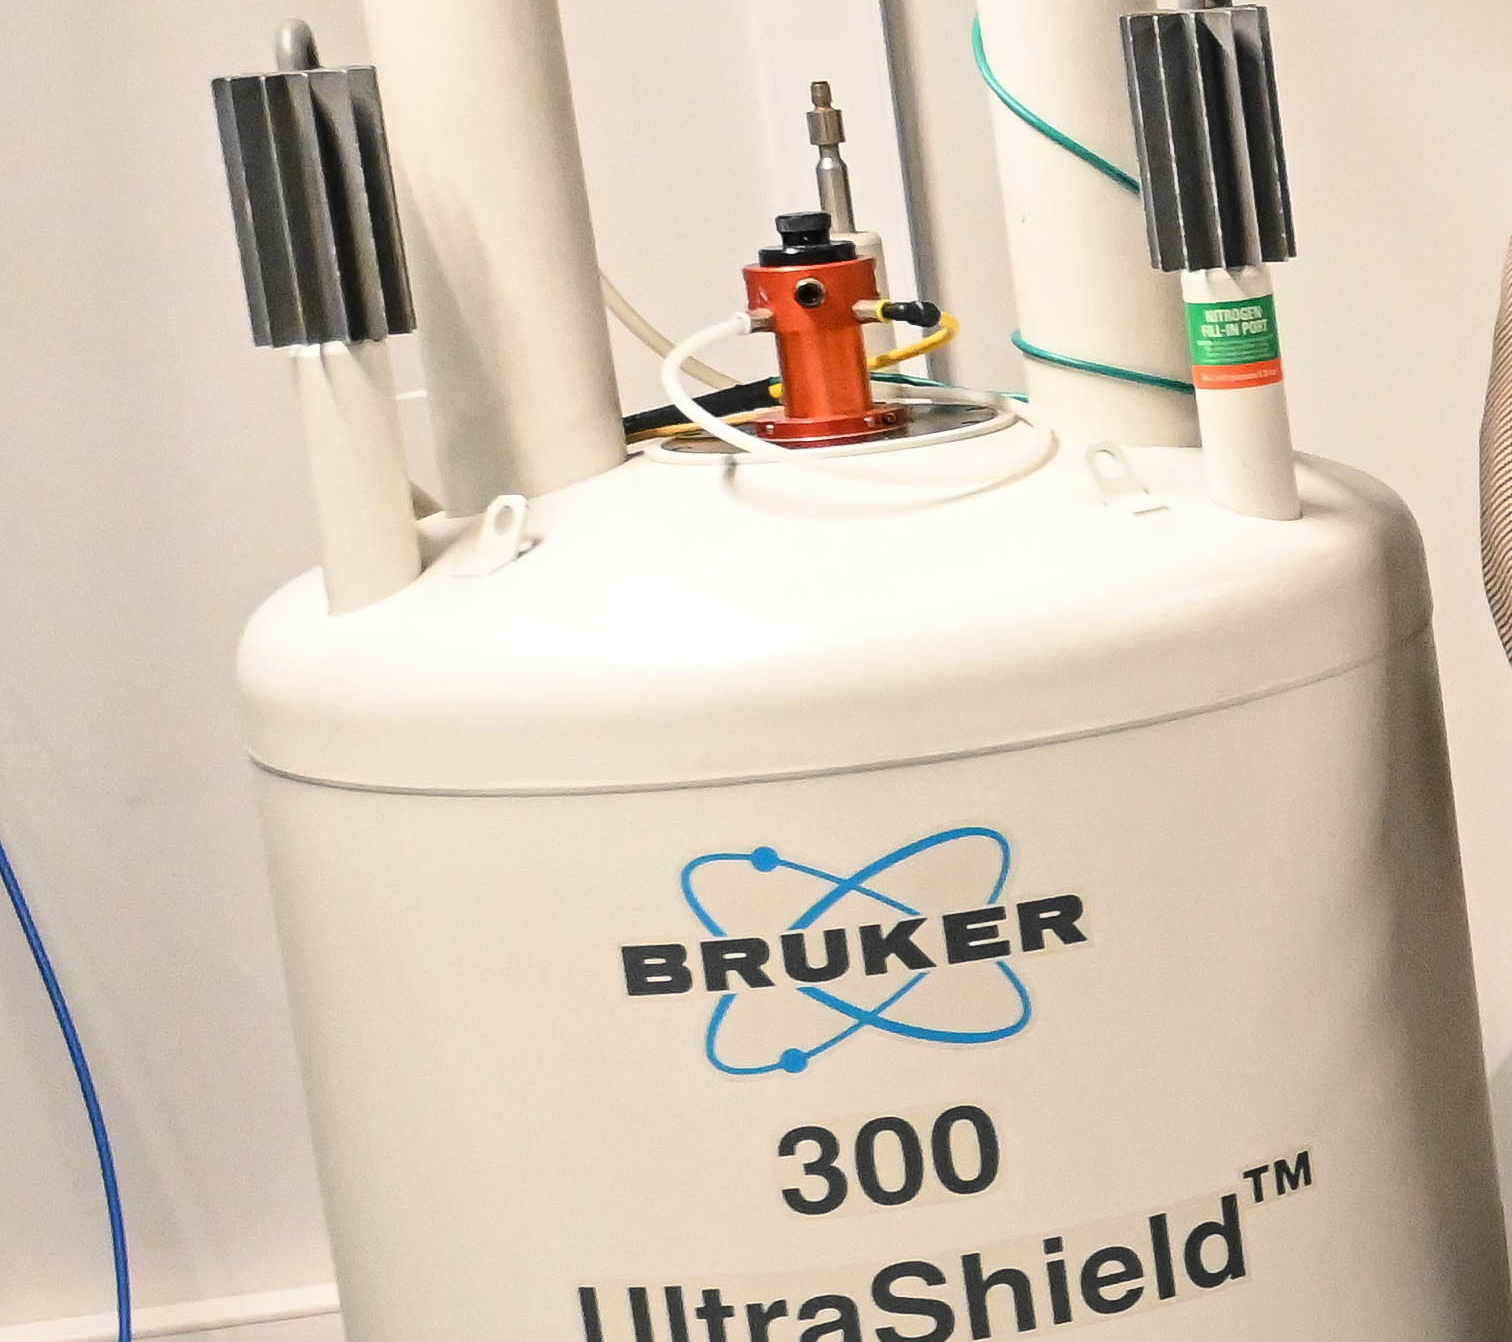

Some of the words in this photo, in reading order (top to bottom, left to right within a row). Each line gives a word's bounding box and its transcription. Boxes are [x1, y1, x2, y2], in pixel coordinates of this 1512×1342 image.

[1204, 304, 1263, 323] NITROGEN
[1241, 318, 1267, 336] PORT
[620, 893, 1089, 997] BRUKER
[778, 1105, 999, 1216] 300
